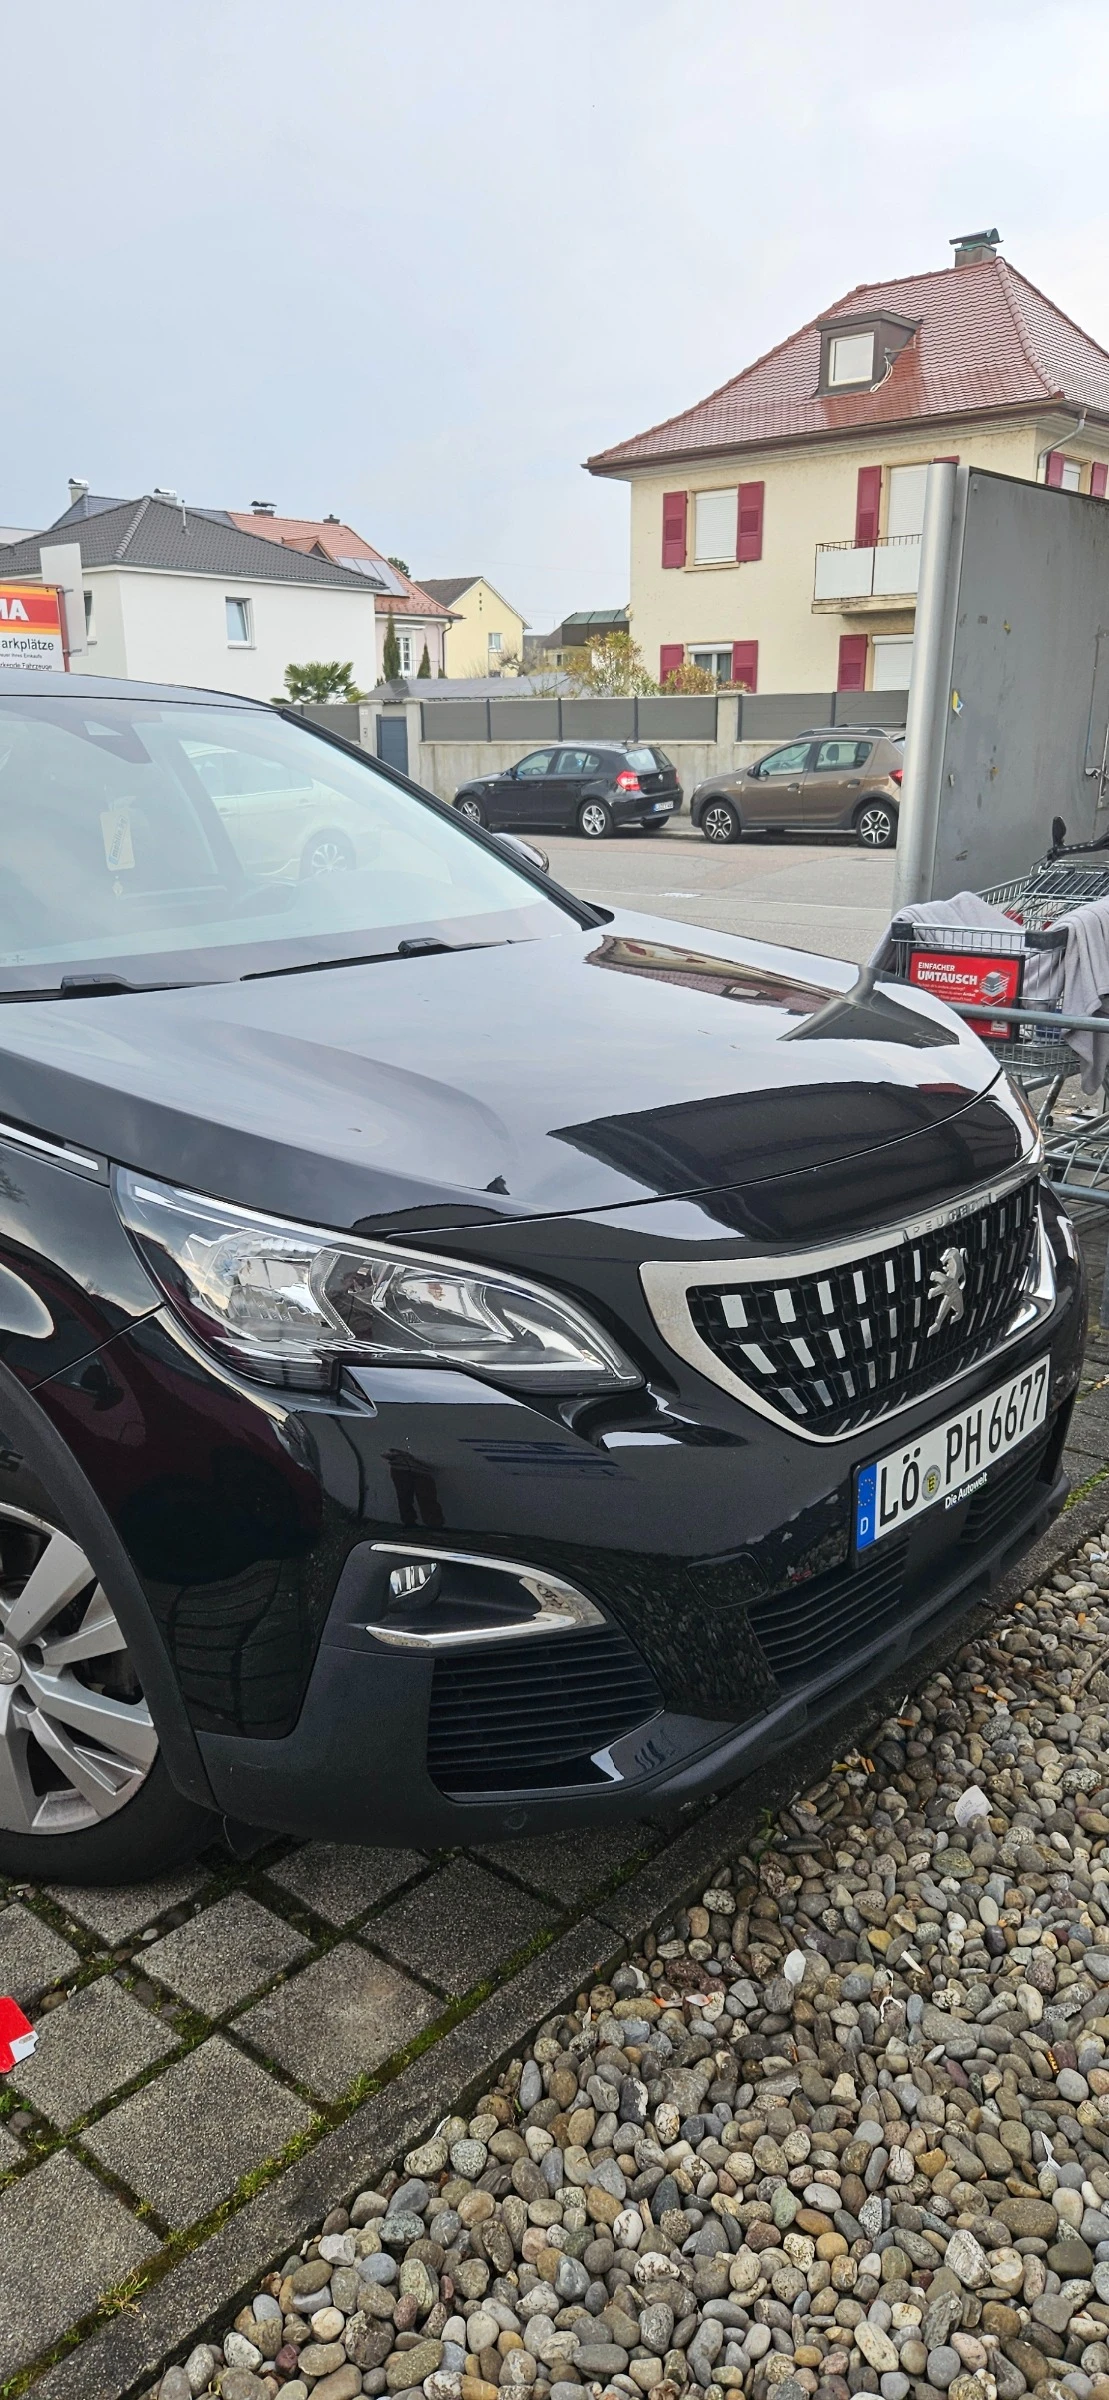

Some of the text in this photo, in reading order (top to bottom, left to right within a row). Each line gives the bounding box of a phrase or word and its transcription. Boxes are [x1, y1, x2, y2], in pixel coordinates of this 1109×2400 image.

[1, 637, 54, 652] arkplätze
[917, 961, 956, 972] EINFACHER
[917, 970, 978, 985] UMTAUSCH
[912, 1197, 987, 1235] PEUGEOT
[879, 1363, 1047, 1528] LÖ PH 6677
[944, 1471, 988, 1510] Die Autowelt
[860, 1516, 869, 1536] D
